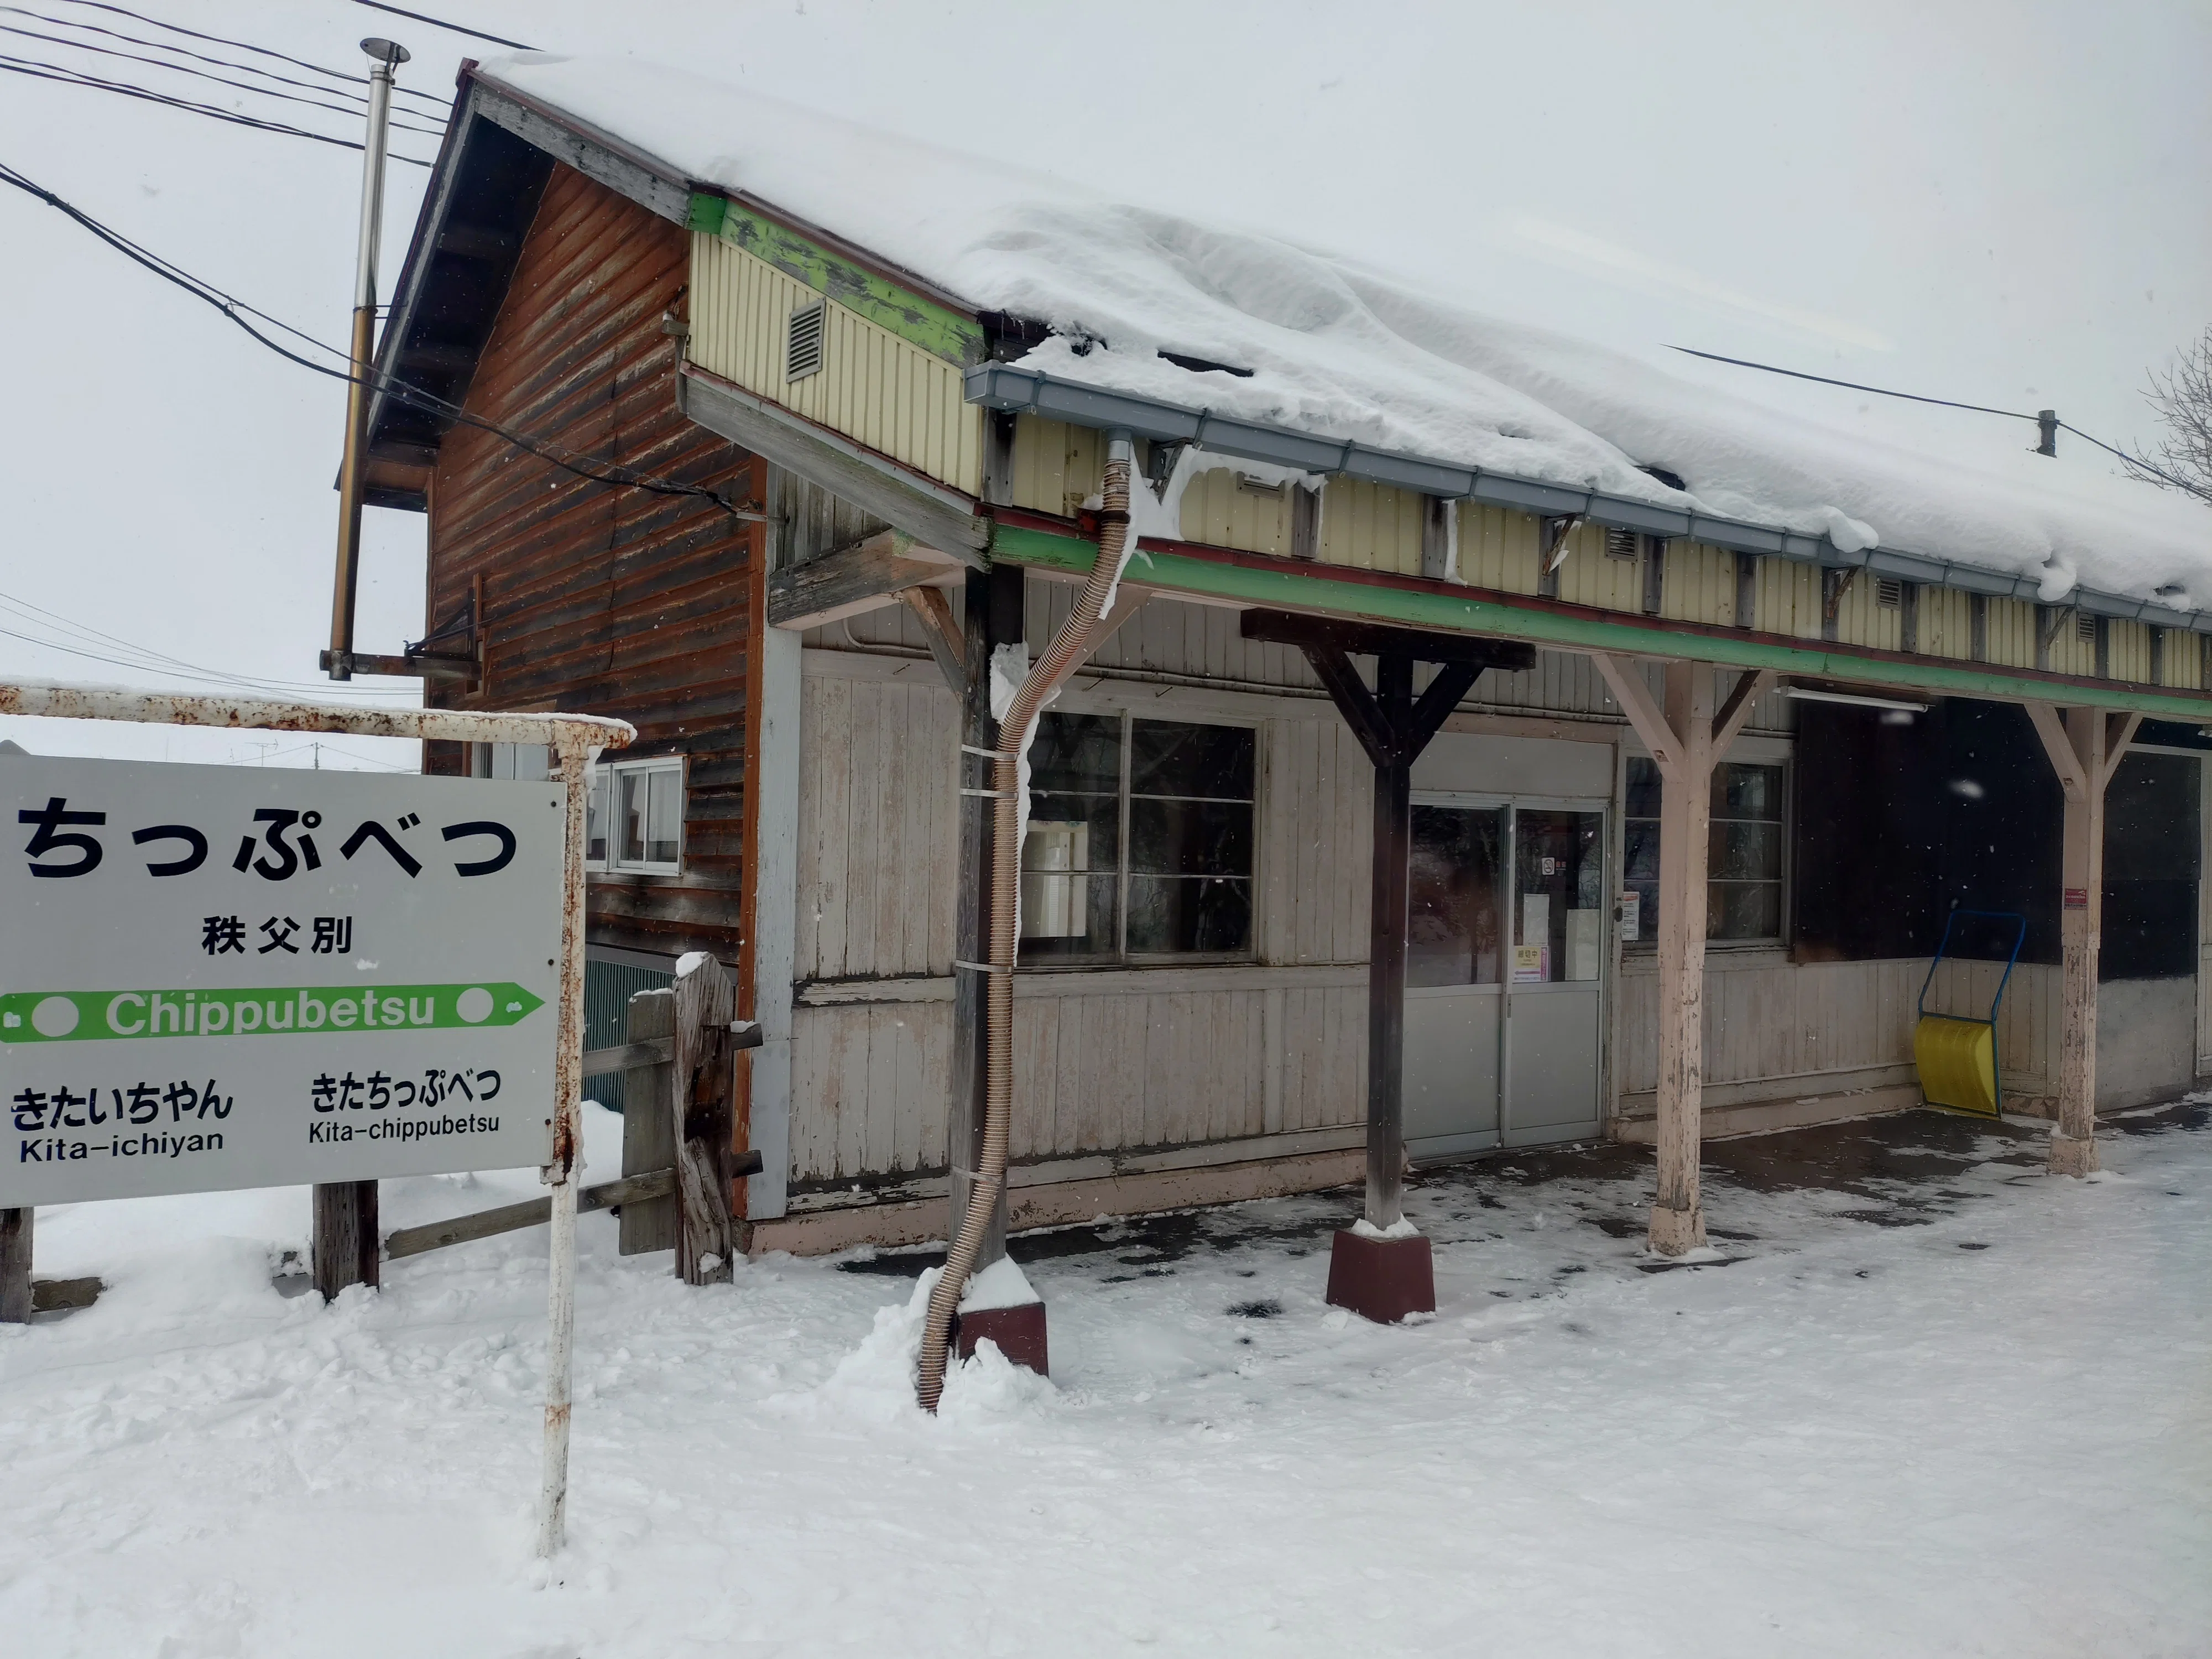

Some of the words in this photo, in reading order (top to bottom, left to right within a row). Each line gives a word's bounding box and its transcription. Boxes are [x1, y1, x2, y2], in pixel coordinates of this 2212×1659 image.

[18, 797, 516, 881] ちっぷべつ
[202, 916, 352, 955] 秩父別
[106, 990, 435, 1035] Chippubetsu
[11, 1079, 233, 1131] きたいちやん
[311, 1068, 500, 1112] きたちっぷべつ
[20, 1131, 223, 1162] Kita-ichiyan
[309, 1113, 499, 1143] Kita-chippubetsu
